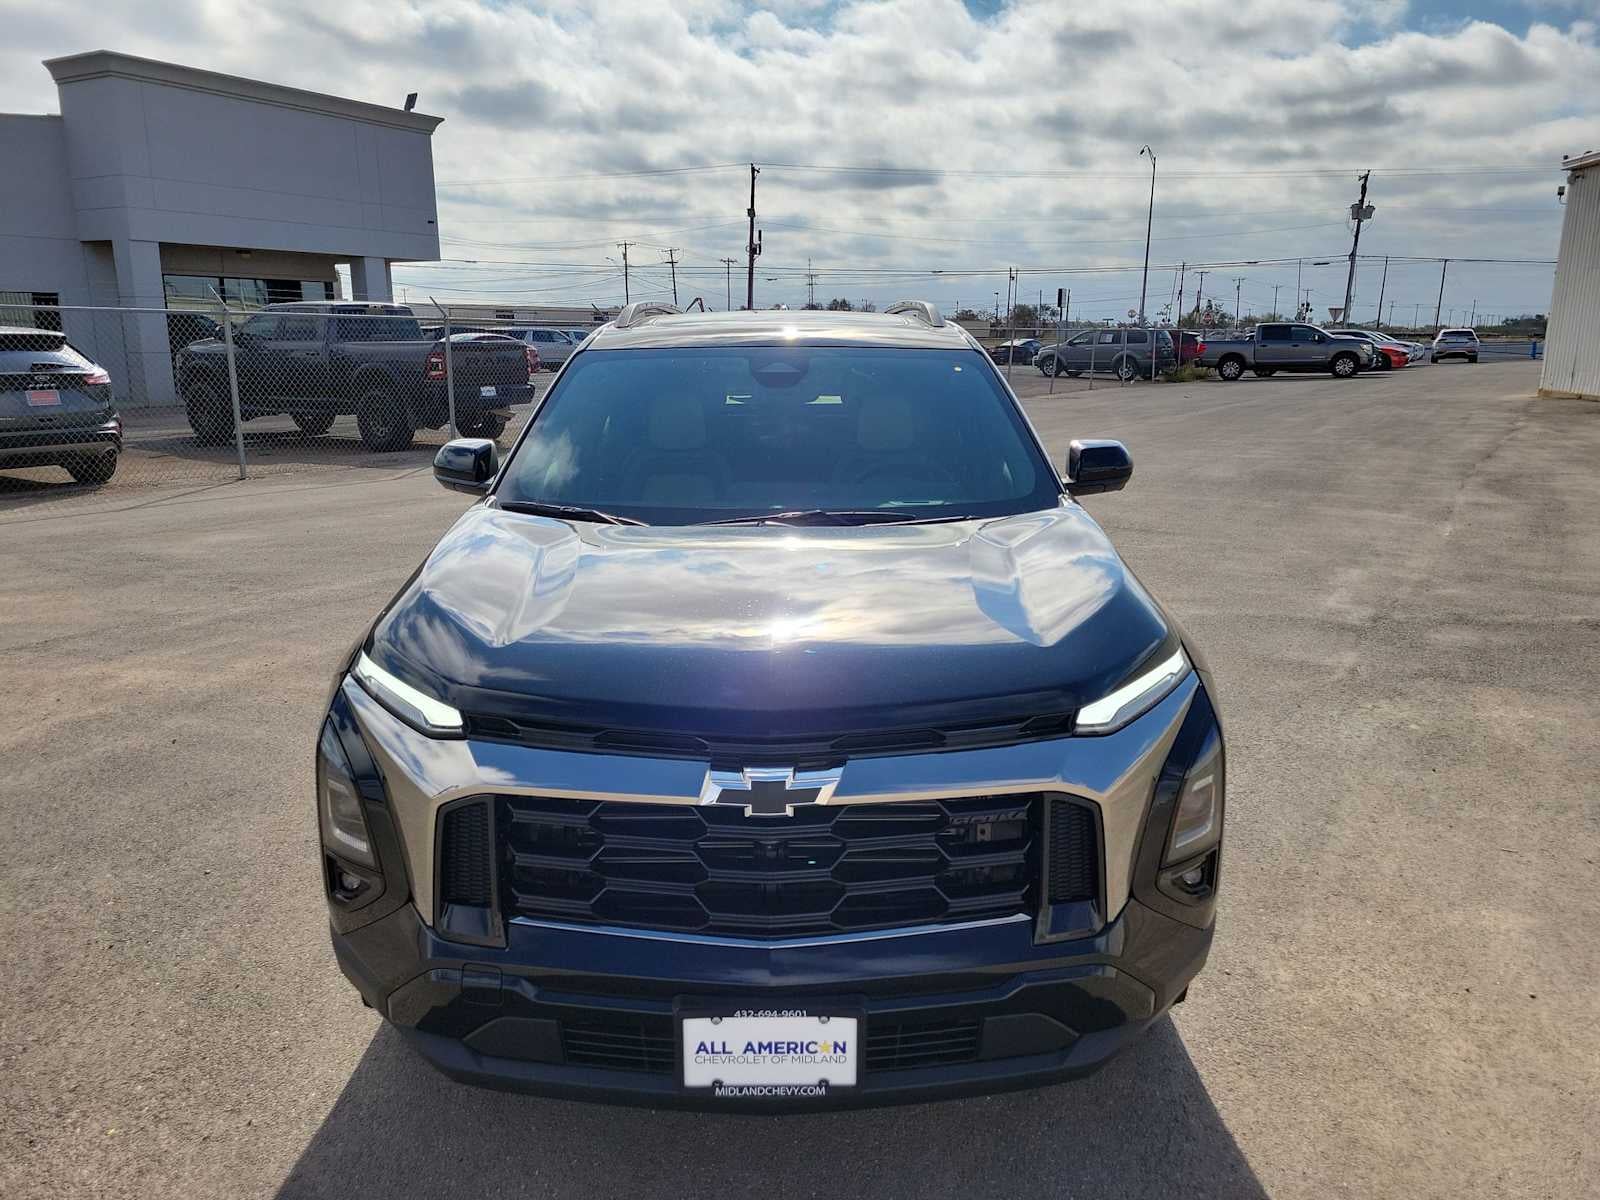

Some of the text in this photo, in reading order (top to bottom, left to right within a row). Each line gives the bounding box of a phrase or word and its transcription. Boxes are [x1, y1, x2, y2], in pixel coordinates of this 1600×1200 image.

[734, 1010, 807, 1018] 432-694-9601
[695, 1041, 732, 1055] ALL
[694, 1054, 848, 1065] CHEVROLET OF MIDLAND
[715, 1086, 826, 1096] MIDLANDCHEVY.COM
